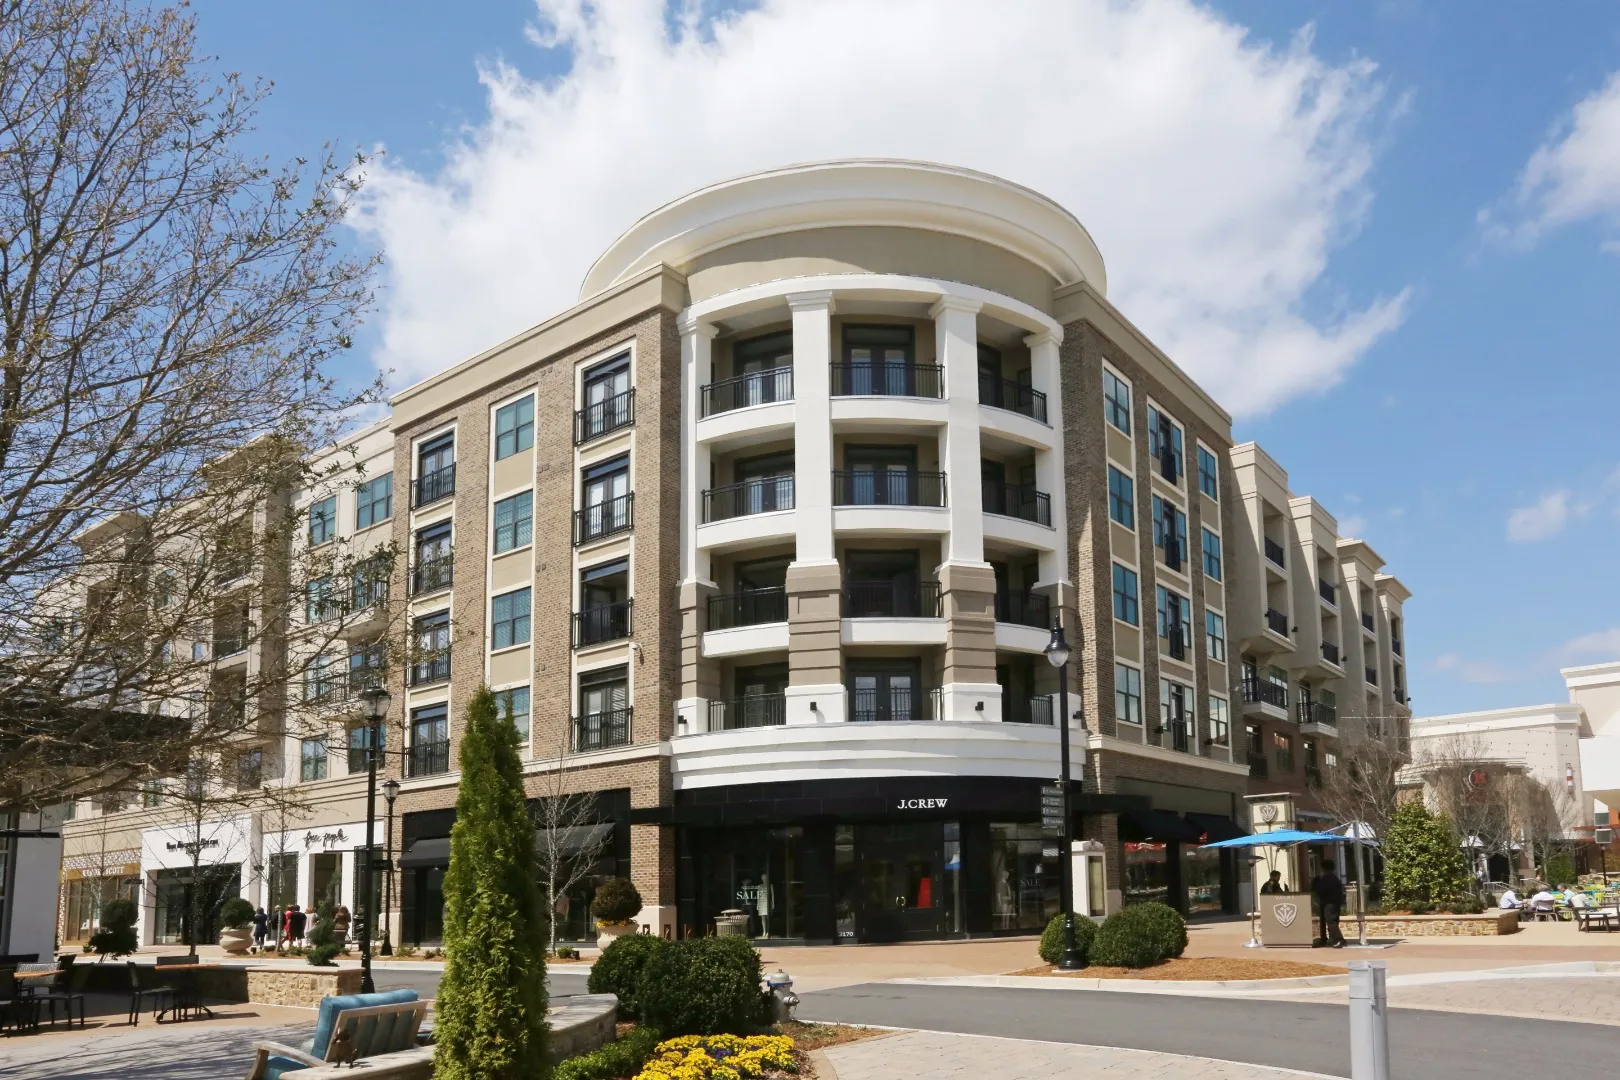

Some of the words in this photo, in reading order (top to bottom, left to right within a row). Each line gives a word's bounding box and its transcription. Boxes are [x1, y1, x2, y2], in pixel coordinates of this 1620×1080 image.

[897, 798, 948, 809] J.CREW
[303, 830, 321, 848] free
[322, 828, 348, 848] people
[105, 866, 125, 875] SCOTT
[736, 891, 763, 900] SALE
